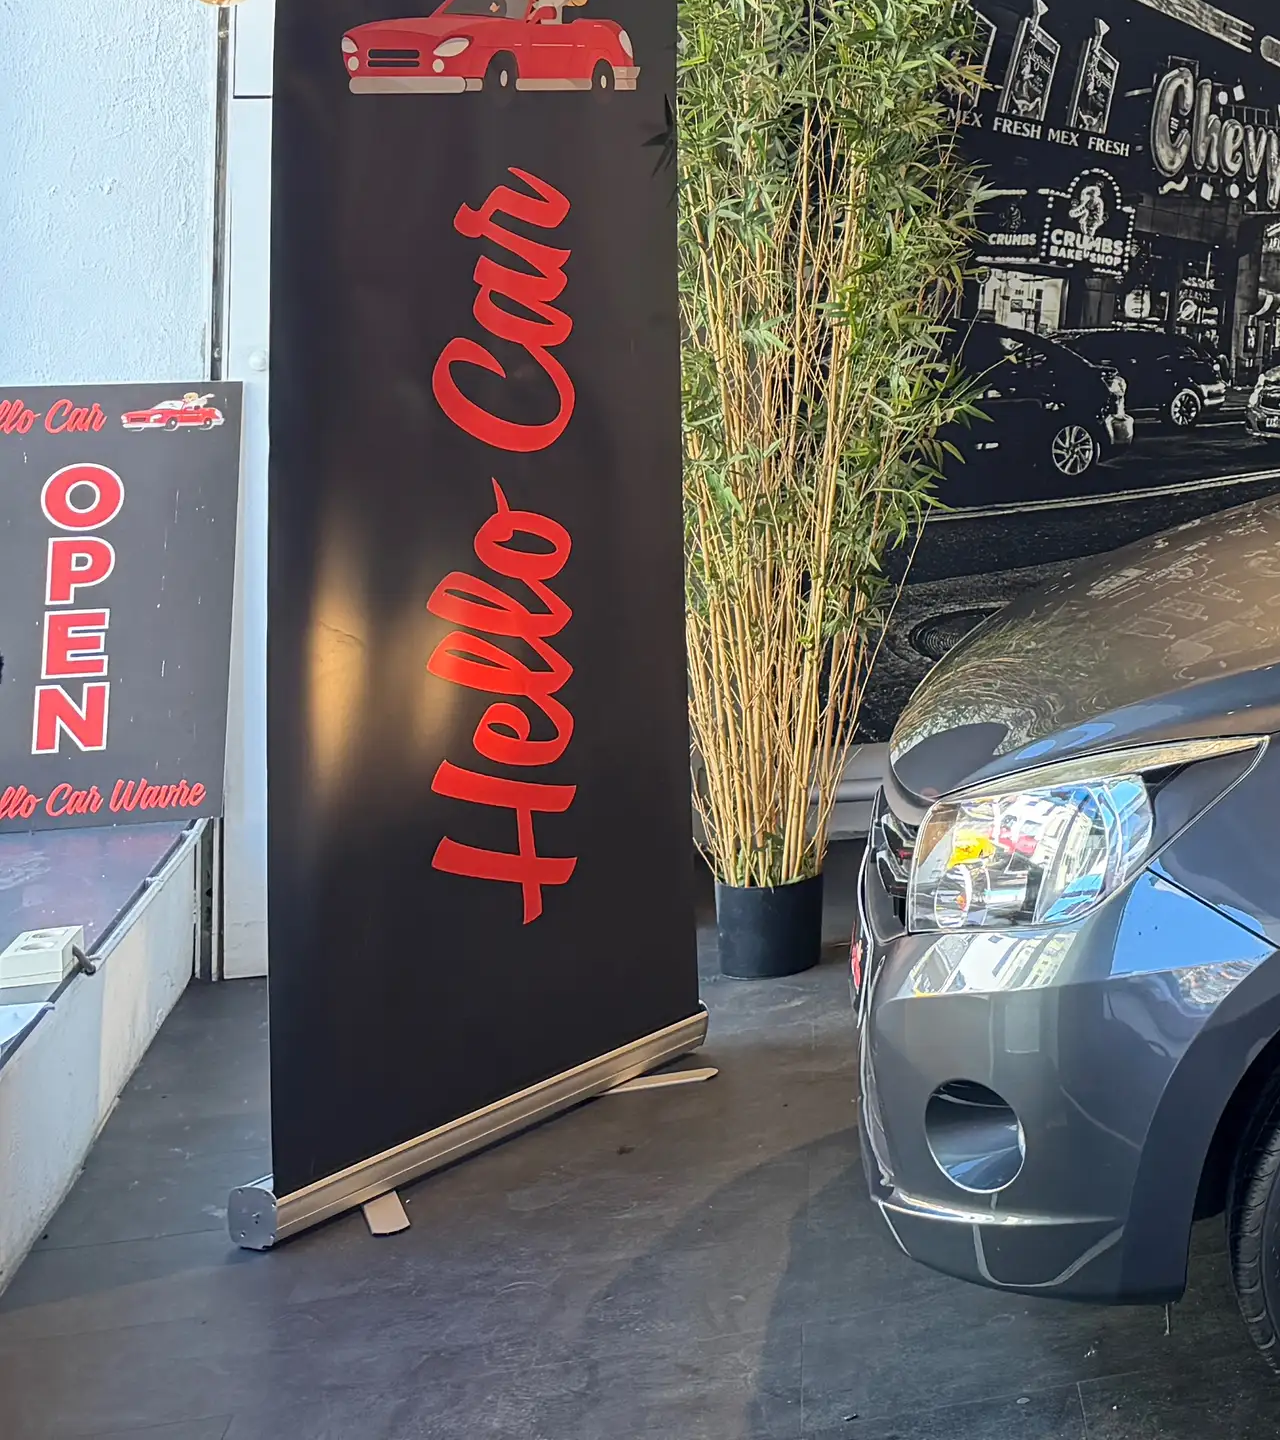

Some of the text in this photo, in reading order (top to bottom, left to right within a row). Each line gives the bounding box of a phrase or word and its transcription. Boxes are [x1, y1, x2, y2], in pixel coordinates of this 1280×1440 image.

[947, 108, 1130, 157] MEX FRESH MEX FRESH
[988, 233, 1037, 246] CRUMBS
[1050, 246, 1122, 266] BAKE SHOP
[1051, 228, 1124, 255] CRUMBS
[0, 398, 108, 434] llo Car
[427, 166, 578, 925] Hello Car
[32, 462, 125, 755] OPEN
[0, 777, 206, 819] llo Car Wavre
